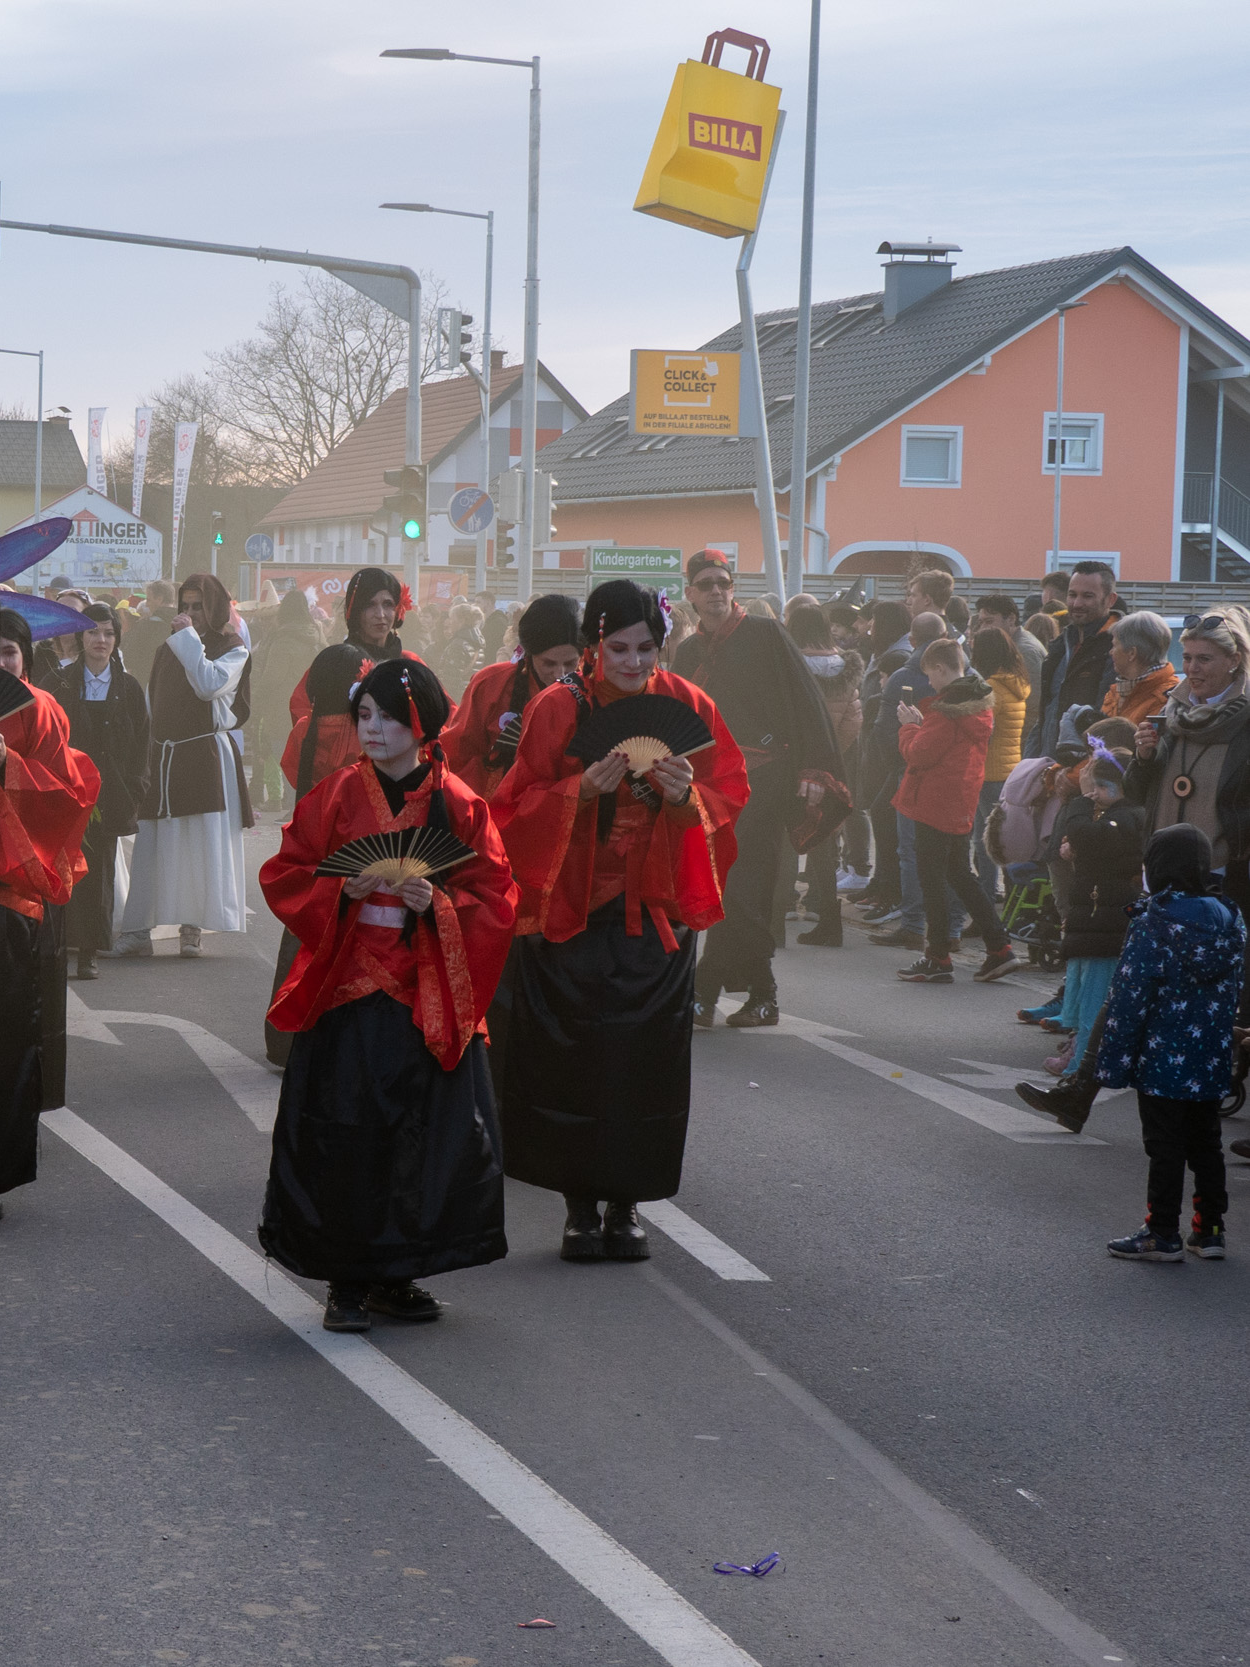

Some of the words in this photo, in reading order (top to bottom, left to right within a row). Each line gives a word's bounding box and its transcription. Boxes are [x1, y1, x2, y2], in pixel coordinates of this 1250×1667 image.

[694, 120, 756, 154] BILLA
[664, 370, 699, 381] CLICK
[700, 372, 707, 380] &
[664, 382, 717, 392] COLLECT
[652, 421, 666, 429] DER
[70, 509, 147, 538] TTINGER
[66, 537, 147, 545] FASSADENSPEZIALIST
[595, 552, 662, 568] Kindergarten
